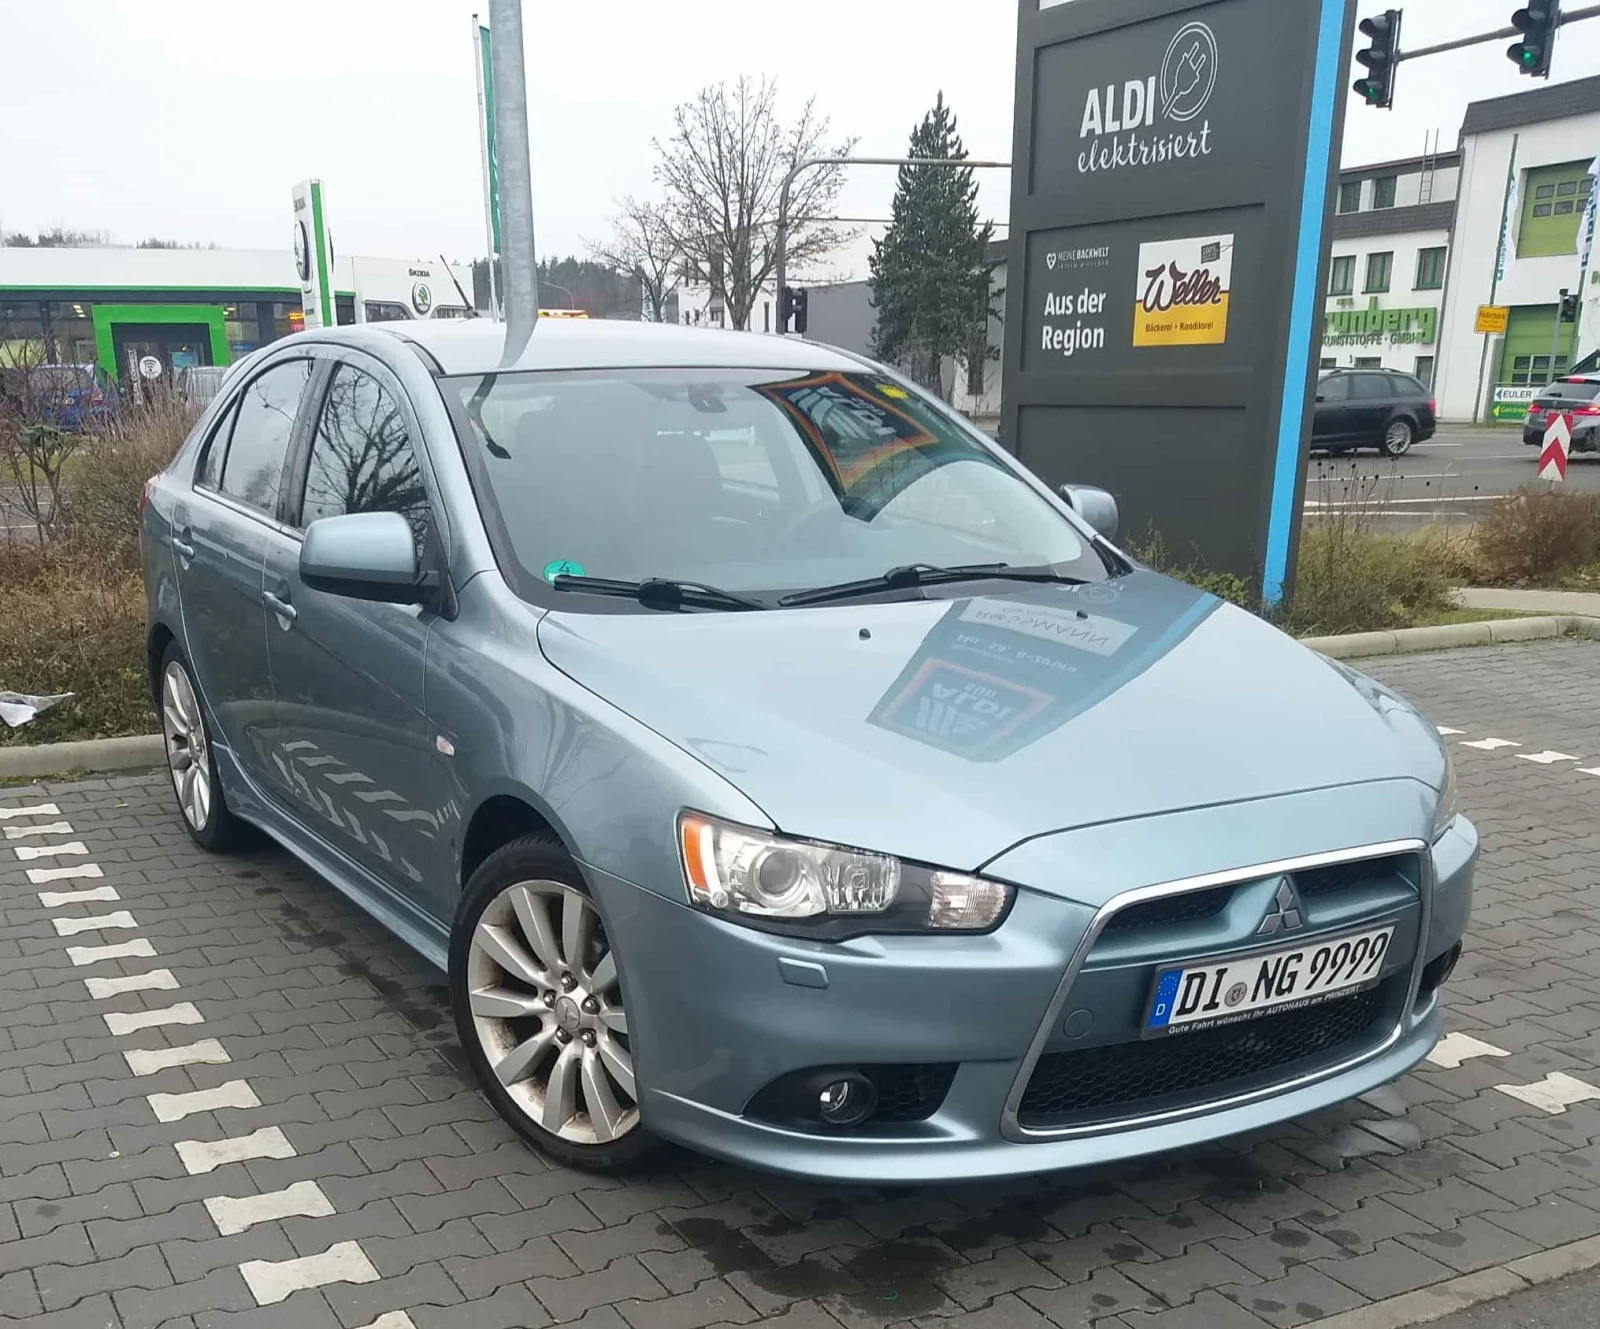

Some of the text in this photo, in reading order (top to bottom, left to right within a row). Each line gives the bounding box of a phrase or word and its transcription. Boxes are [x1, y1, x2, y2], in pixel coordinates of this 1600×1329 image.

[1080, 76, 1156, 138] ALDI
[1078, 120, 1212, 173] elektrisiert
[1076, 246, 1109, 259] BACKWELT
[1043, 287, 1107, 316] Aus der
[1143, 260, 1221, 313] Weller
[1145, 321, 1214, 333] Bäckerei Konditorei
[1325, 296, 1438, 345] rünberg
[1041, 320, 1105, 356] Region
[1322, 332, 1384, 347] KUNSTSTOFFE
[1503, 390, 1532, 399] EULER
[559, 561, 570, 573] 4
[1175, 932, 1389, 1016] DI NG 9999
[1155, 1003, 1165, 1016] D
[1168, 1025, 1189, 1034] Gute
[1191, 1020, 1214, 1030] Fahrt
[1216, 1013, 1251, 1026] wünscht
[1252, 1009, 1264, 1018] Ihr
[1266, 998, 1309, 1015] AUTOHAUS
[1323, 984, 1361, 1001] PRINZERT
